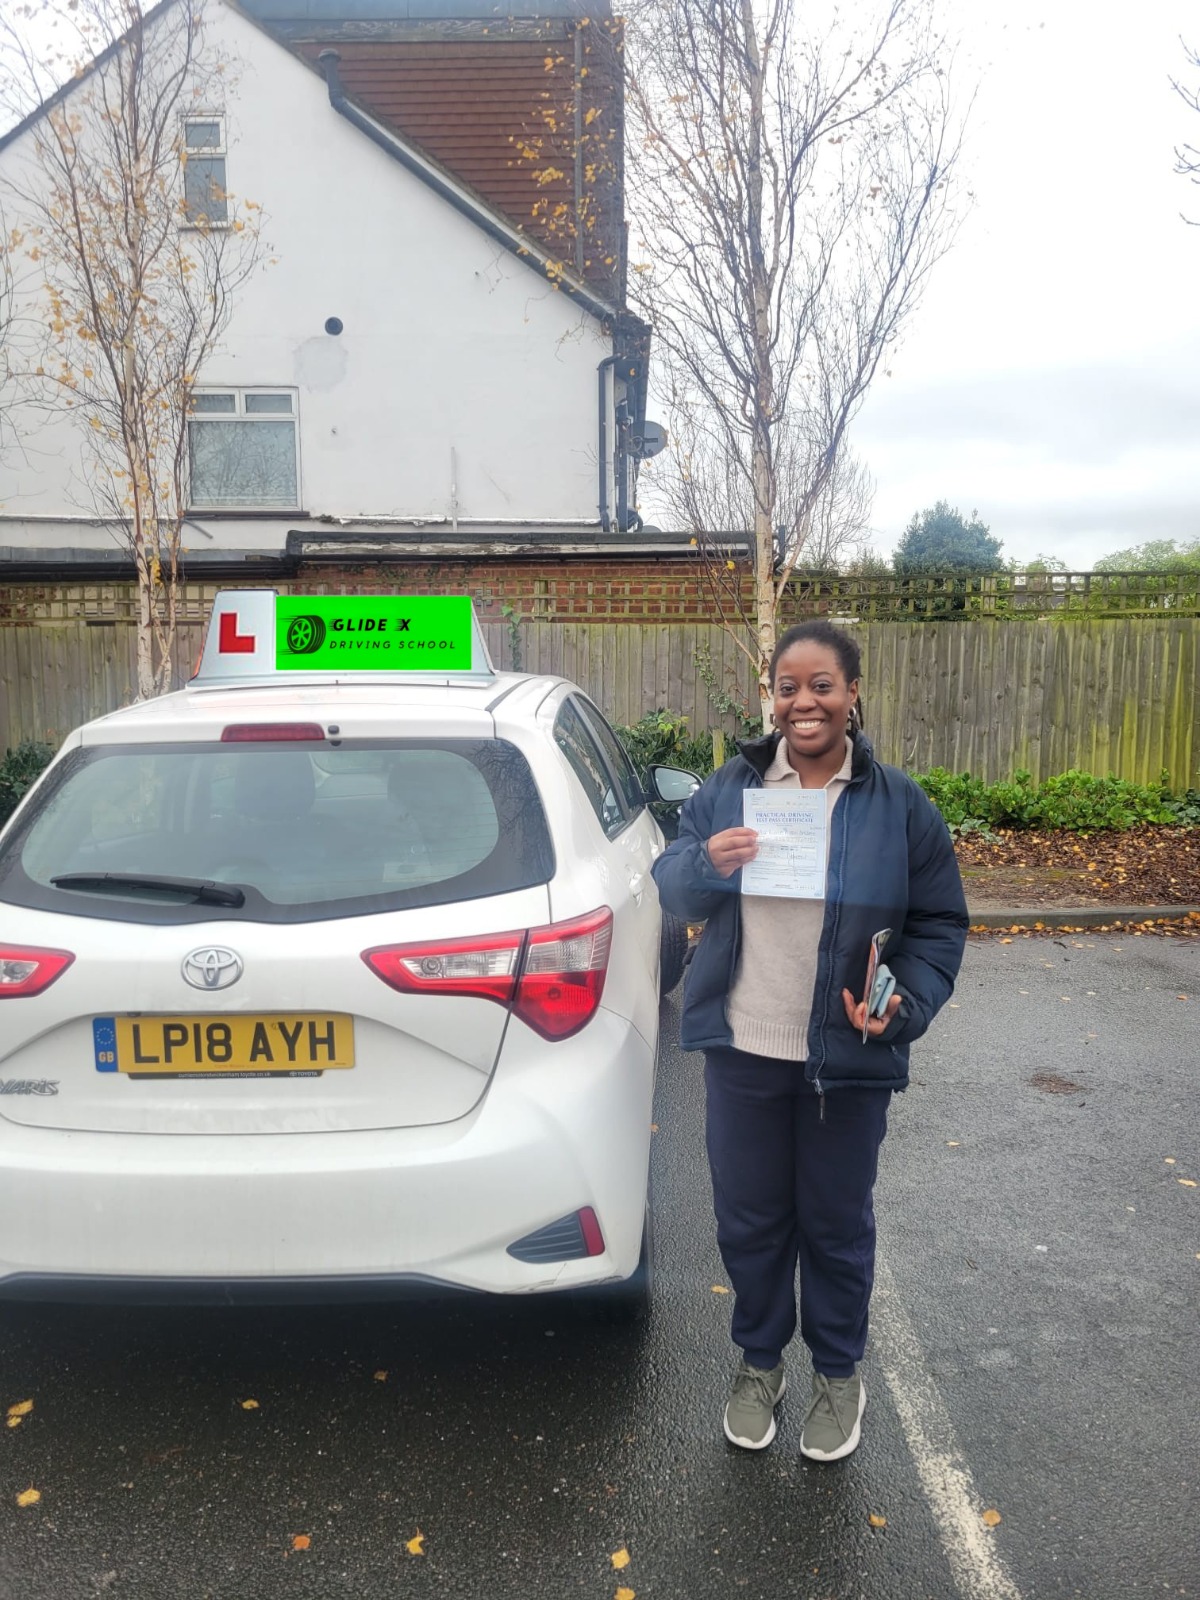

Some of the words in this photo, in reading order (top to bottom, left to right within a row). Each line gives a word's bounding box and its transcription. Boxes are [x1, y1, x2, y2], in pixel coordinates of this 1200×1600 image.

[219, 612, 256, 653] L
[99, 1051, 115, 1063] GB
[131, 1022, 233, 1064] LP18
[249, 1021, 336, 1062] AYH
